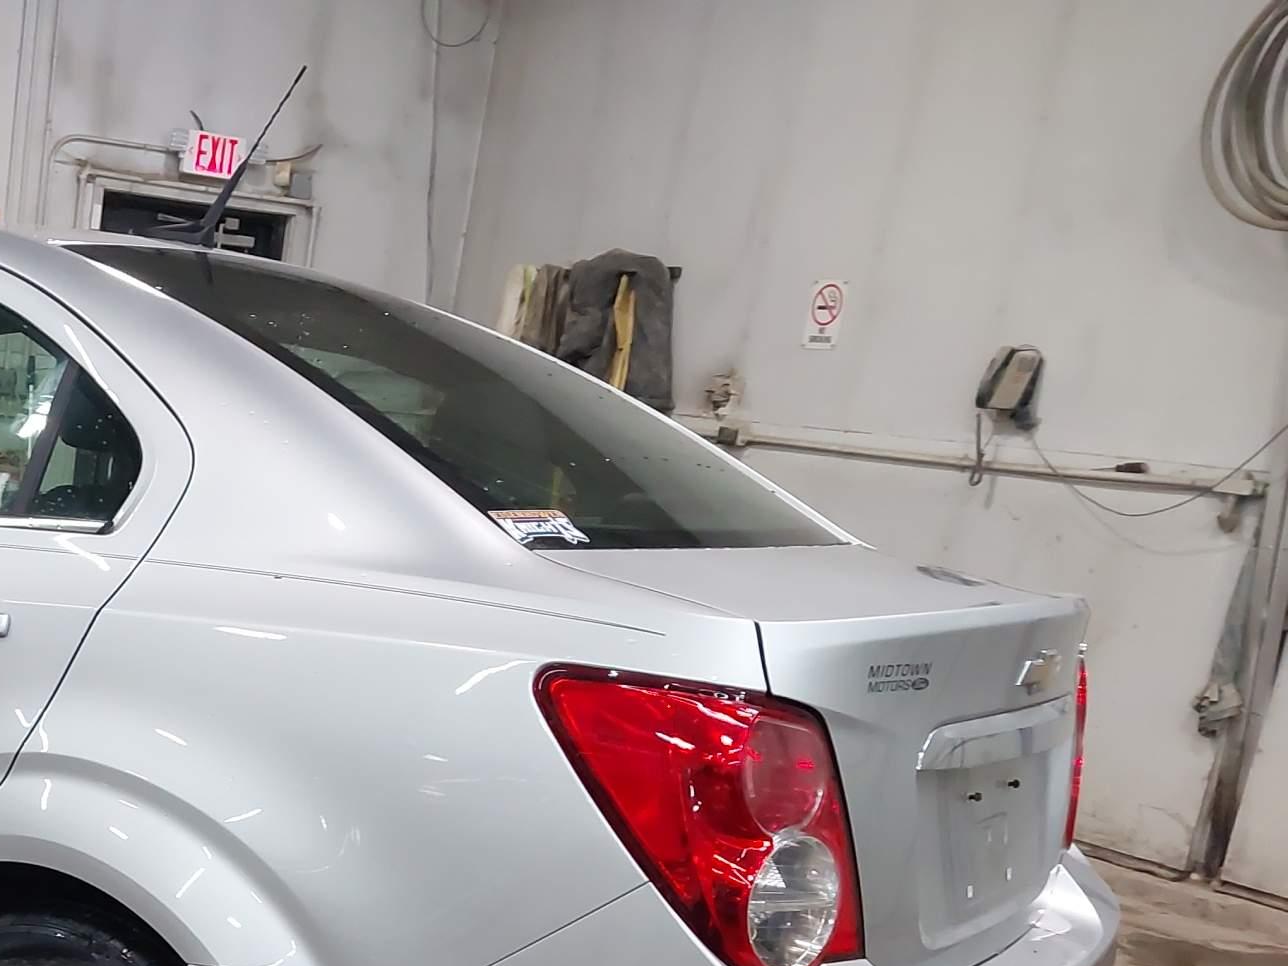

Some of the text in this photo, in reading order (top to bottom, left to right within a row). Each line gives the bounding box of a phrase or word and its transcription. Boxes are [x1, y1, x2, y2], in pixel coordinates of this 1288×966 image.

[195, 134, 239, 175] EXIT
[867, 663, 933, 679] MIDTOWN
[867, 679, 912, 693] MOTORS
